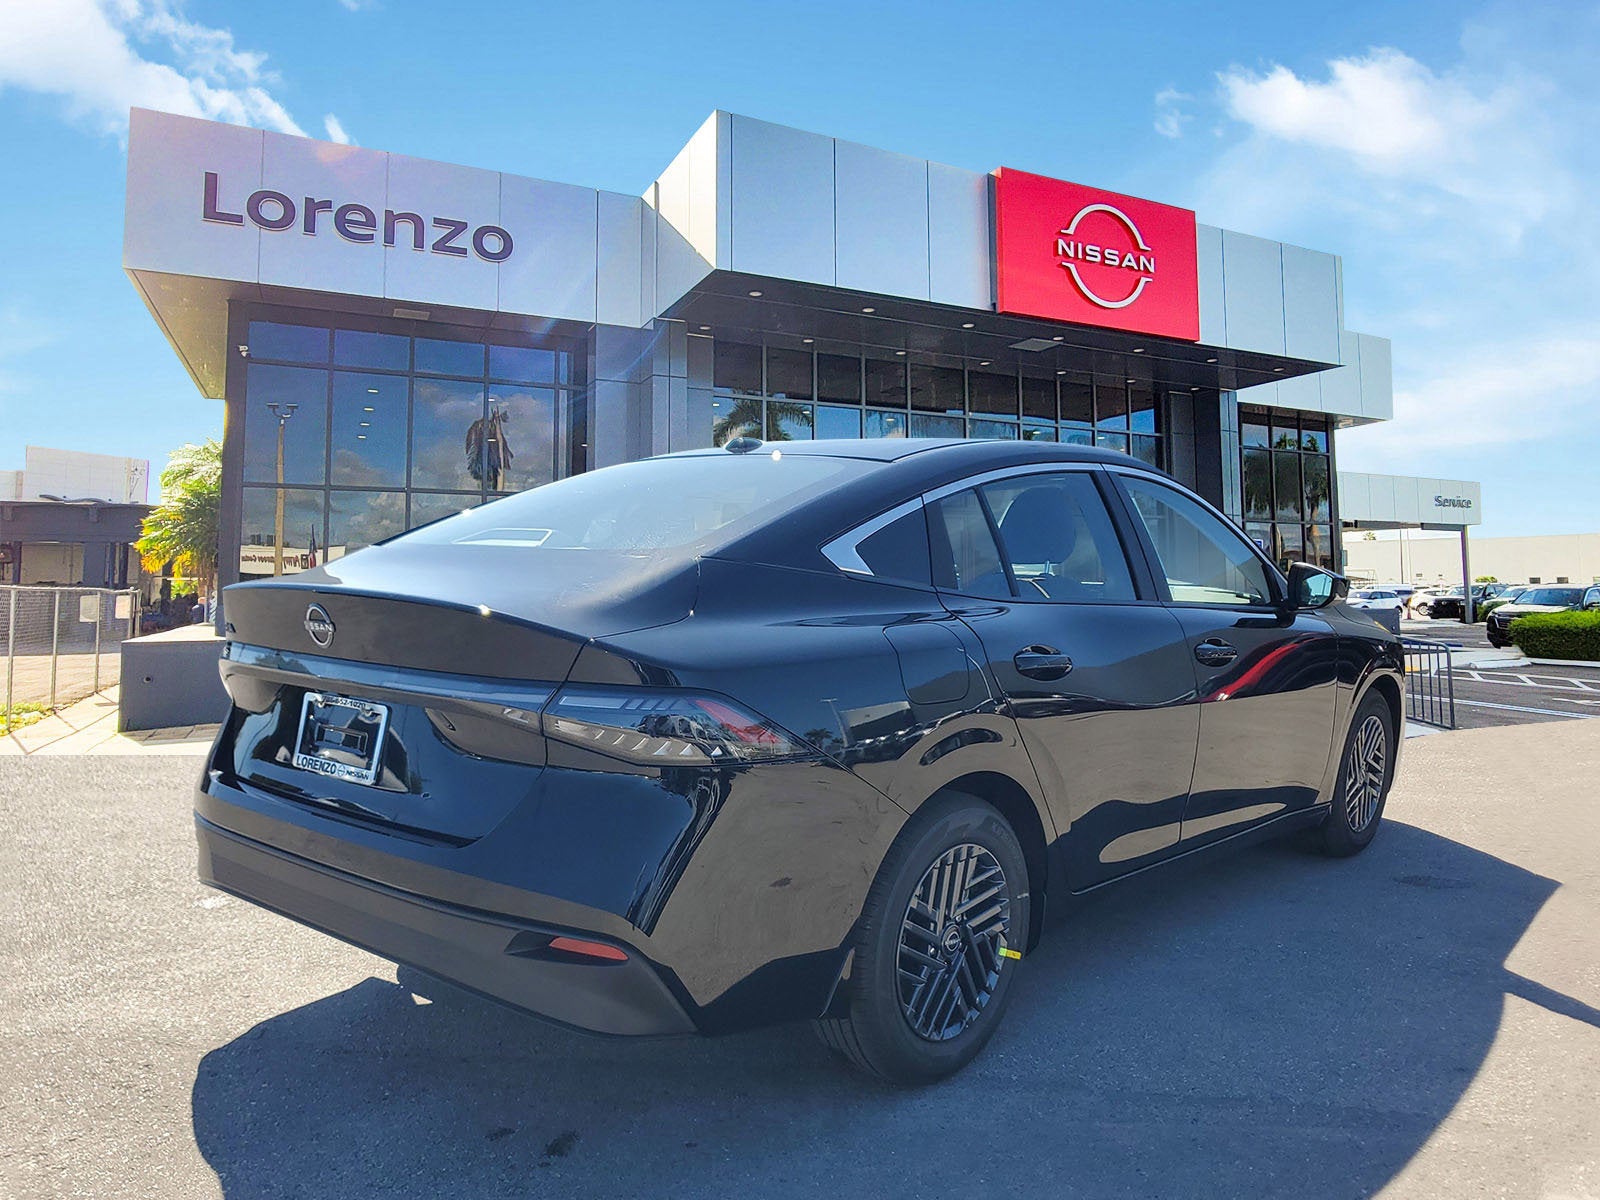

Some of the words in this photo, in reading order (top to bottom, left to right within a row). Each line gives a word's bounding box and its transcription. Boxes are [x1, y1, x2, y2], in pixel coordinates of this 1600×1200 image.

[202, 171, 514, 263] Lorenzo
[1057, 238, 1155, 273] NISSAN
[1434, 496, 1472, 508] Service
[296, 755, 337, 774] LORENZO
